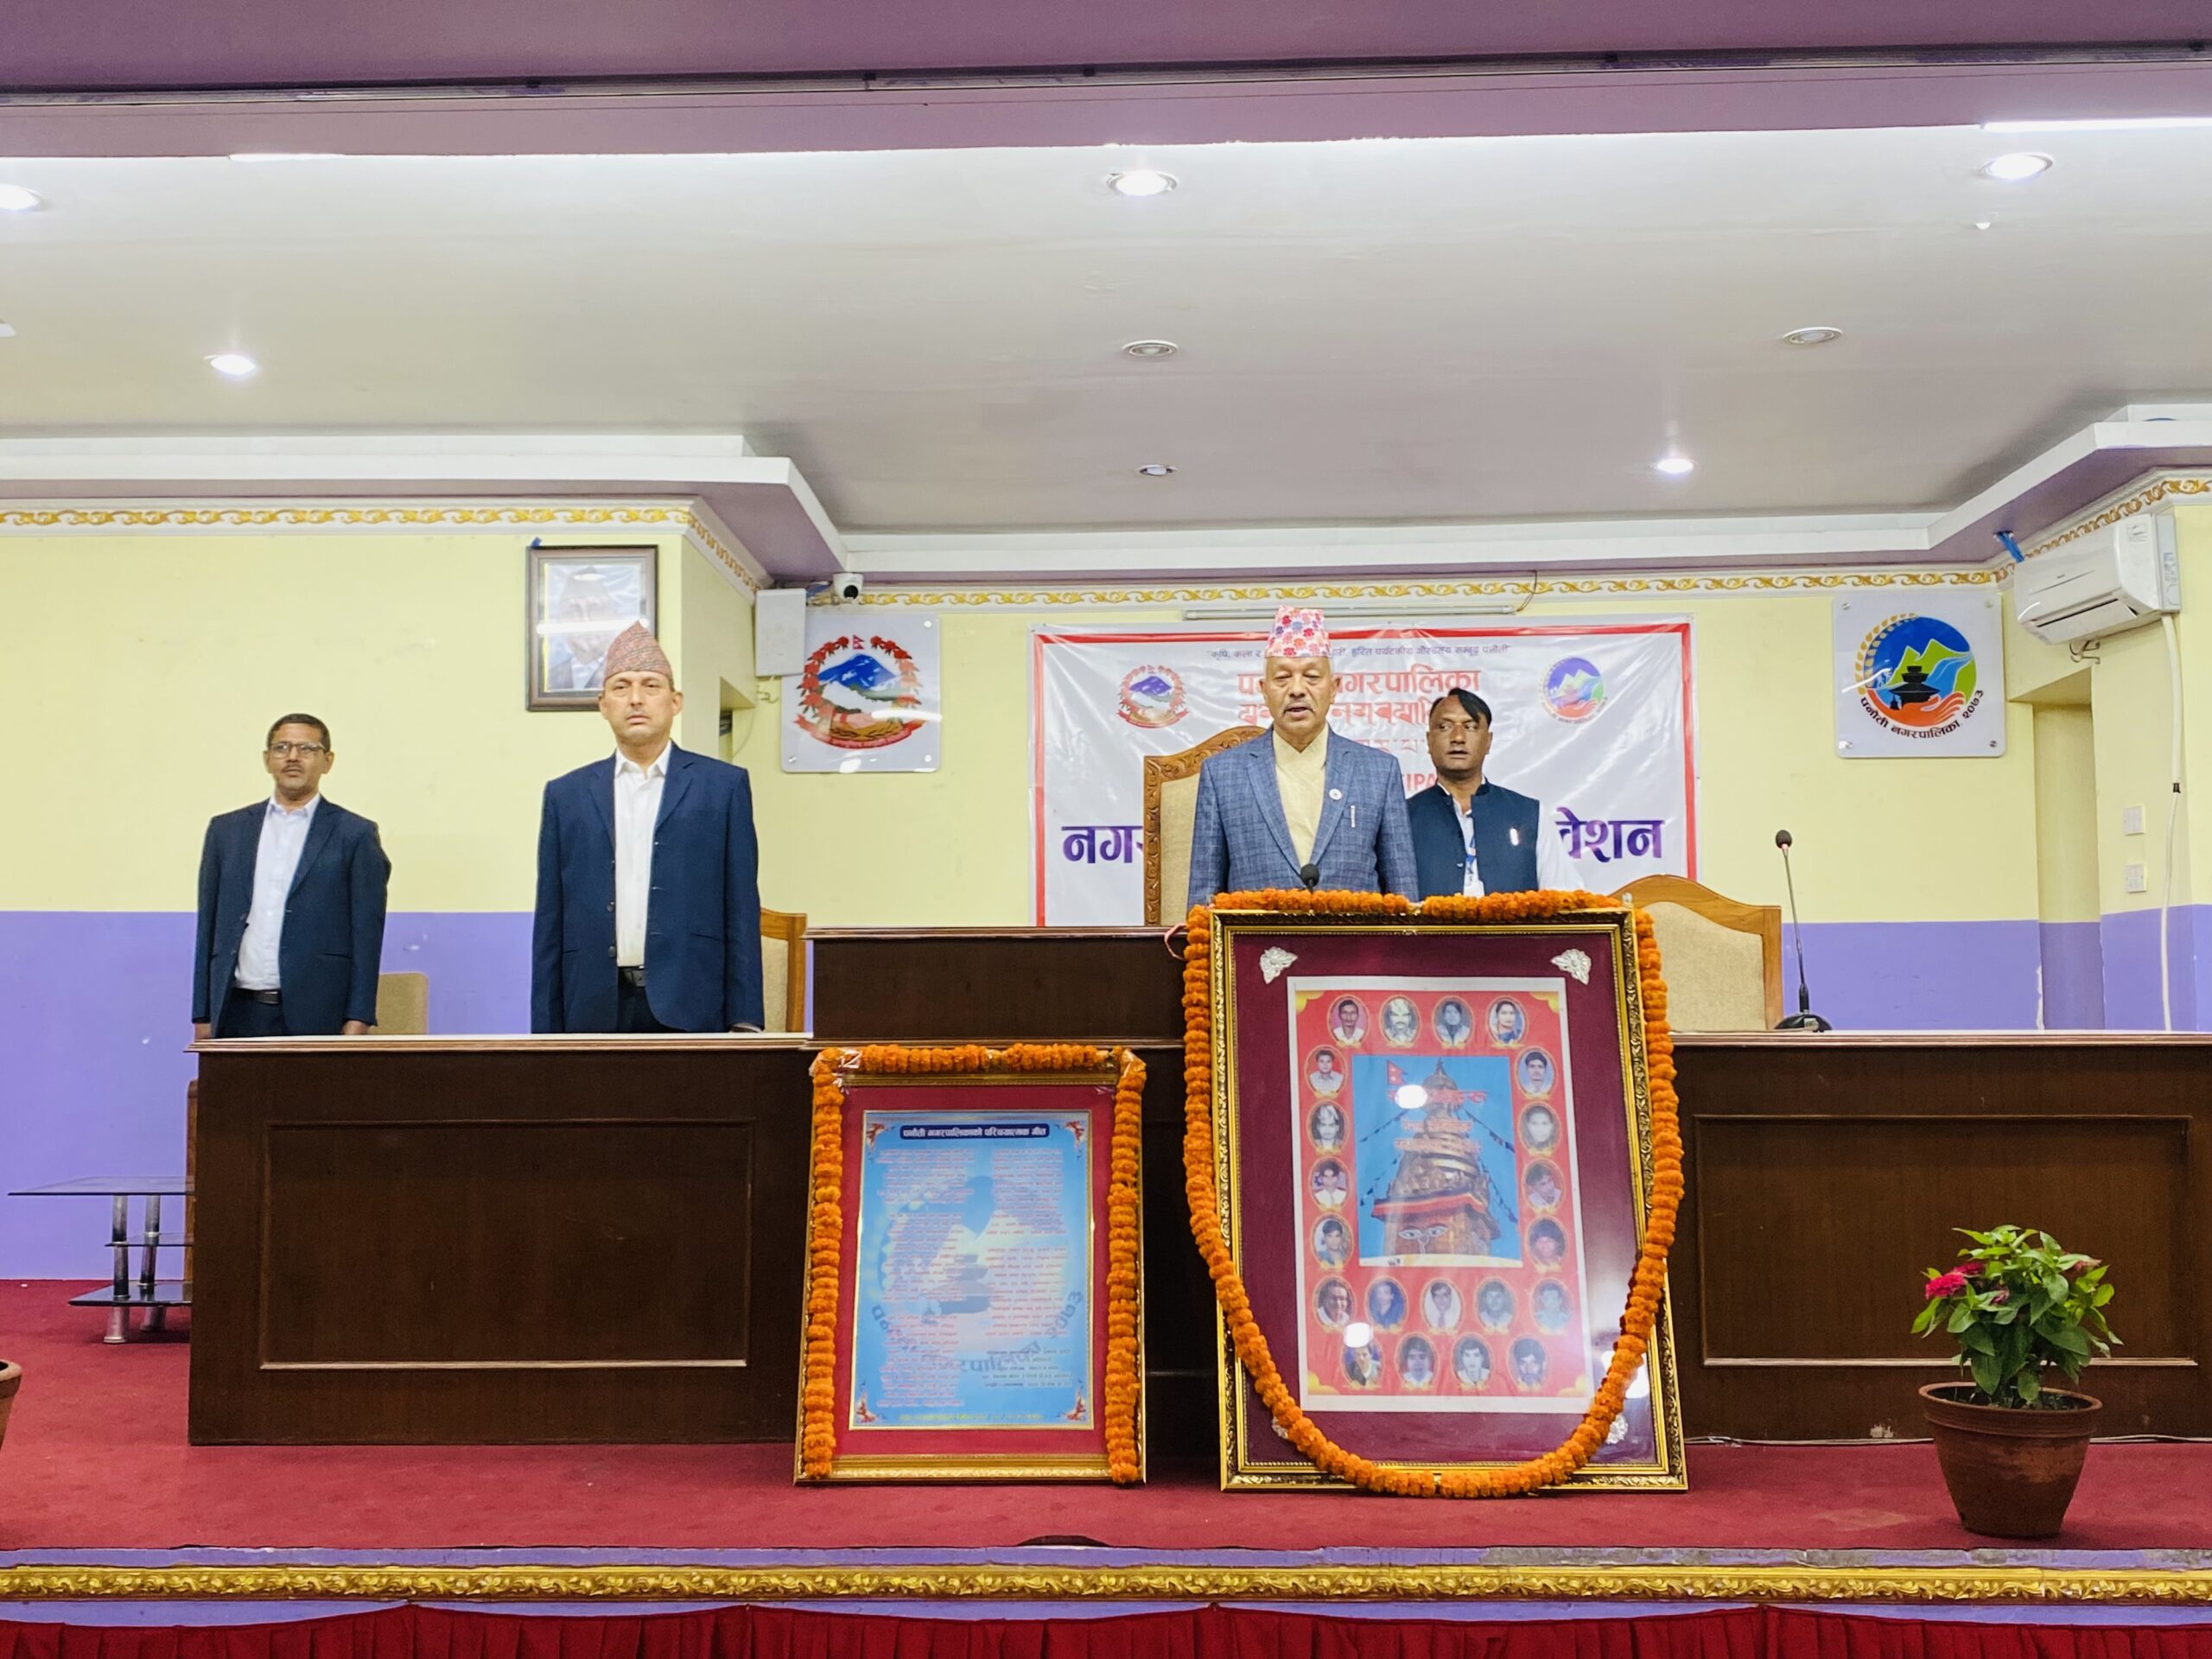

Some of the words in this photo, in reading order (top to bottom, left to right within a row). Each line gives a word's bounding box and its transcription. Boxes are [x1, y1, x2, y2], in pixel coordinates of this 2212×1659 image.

[1860, 696, 1889, 728] पनौती
[1891, 720, 1961, 739] नगरपालिका
[1962, 690, 1985, 719] २०७३
